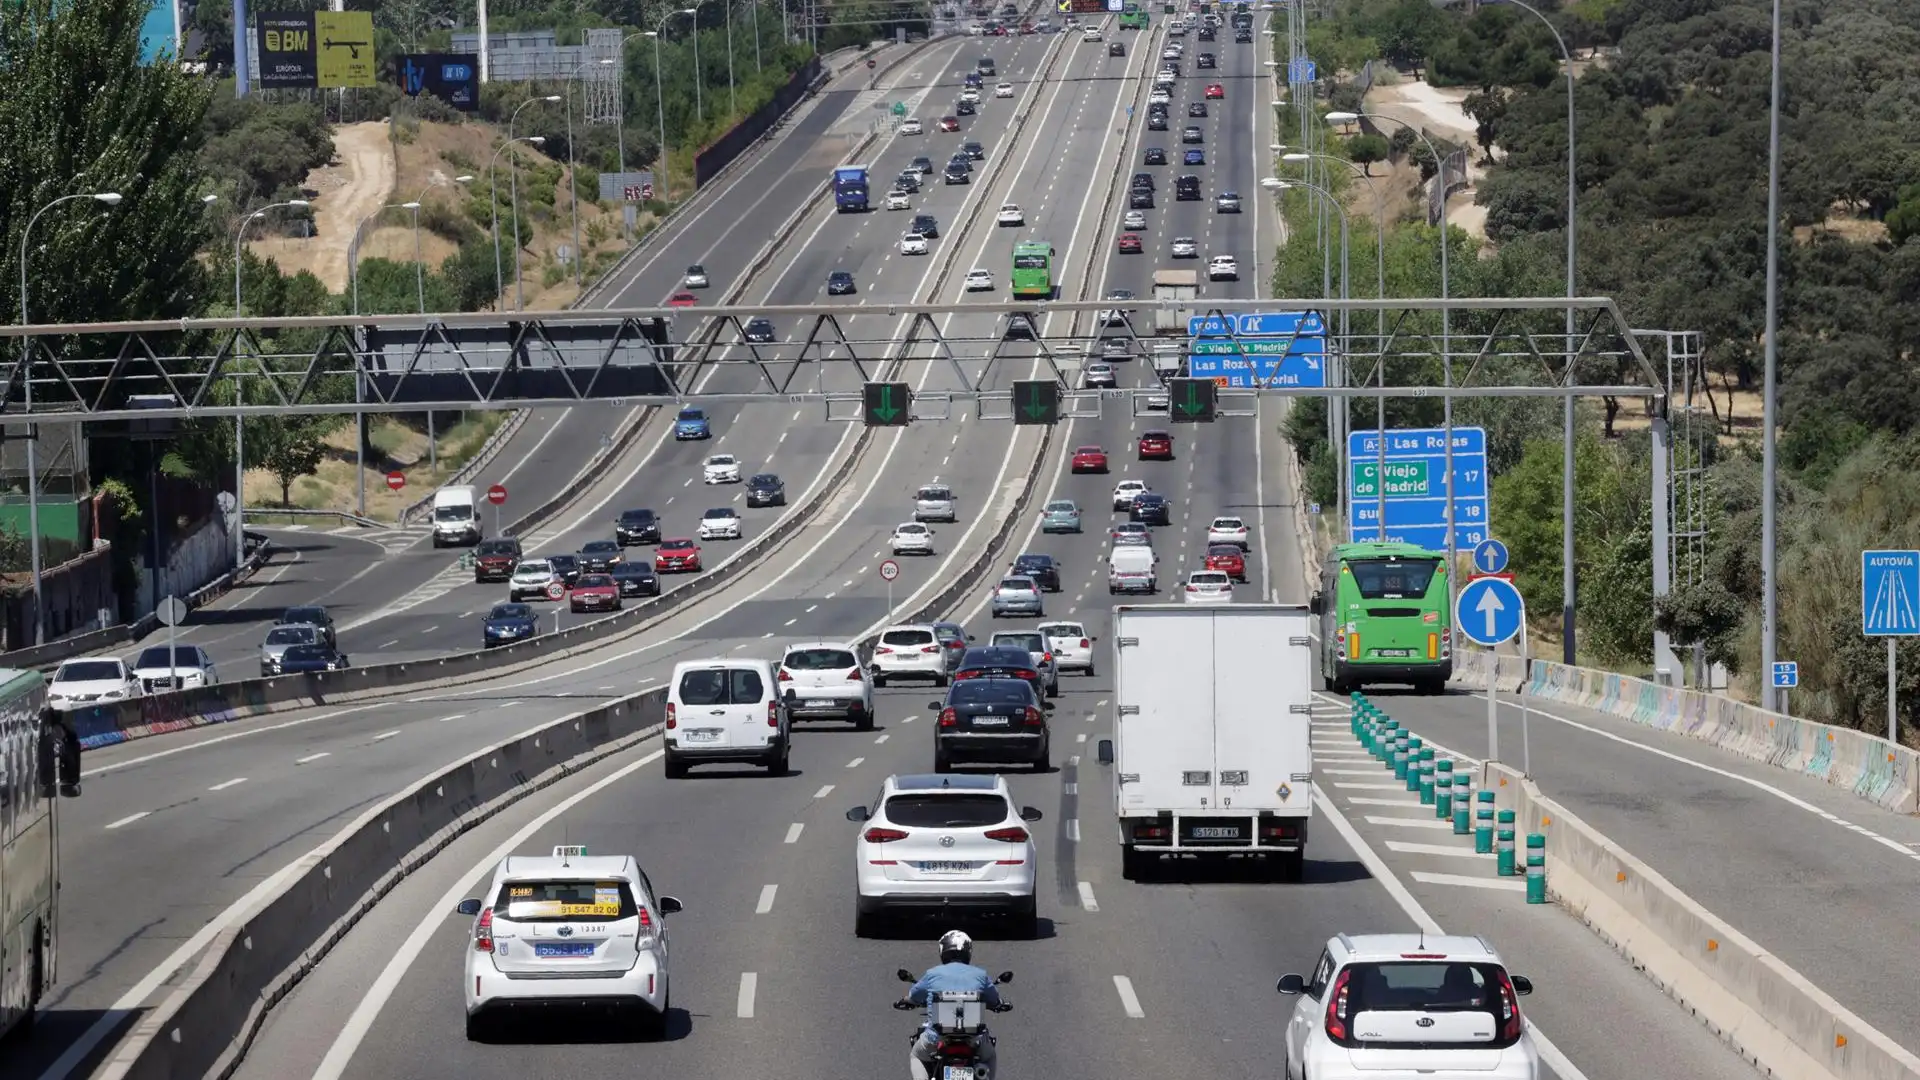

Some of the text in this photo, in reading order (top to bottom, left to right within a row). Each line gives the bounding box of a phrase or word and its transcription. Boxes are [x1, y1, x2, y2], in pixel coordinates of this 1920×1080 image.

[283, 31, 308, 51] BM
[1209, 344, 1233, 353] Viejo
[1254, 343, 1288, 352] Madrid
[1195, 361, 1216, 370] Las
[1223, 360, 1257, 370] Rozas
[1232, 376, 1244, 386] El
[1366, 436, 1468, 450] A- Las Roas
[1383, 464, 1418, 478] Viejo
[1464, 470, 1479, 482] 17
[1356, 482, 1374, 493] de
[1465, 506, 1480, 517] 18
[1466, 532, 1481, 544] 19
[1870, 556, 1914, 566] AUTOVÍA
[884, 566, 895, 574] 120
[1782, 674, 1789, 684] 2
[575, 905, 590, 913] 547
[594, 905, 604, 913] 82
[607, 906, 618, 914] 00
